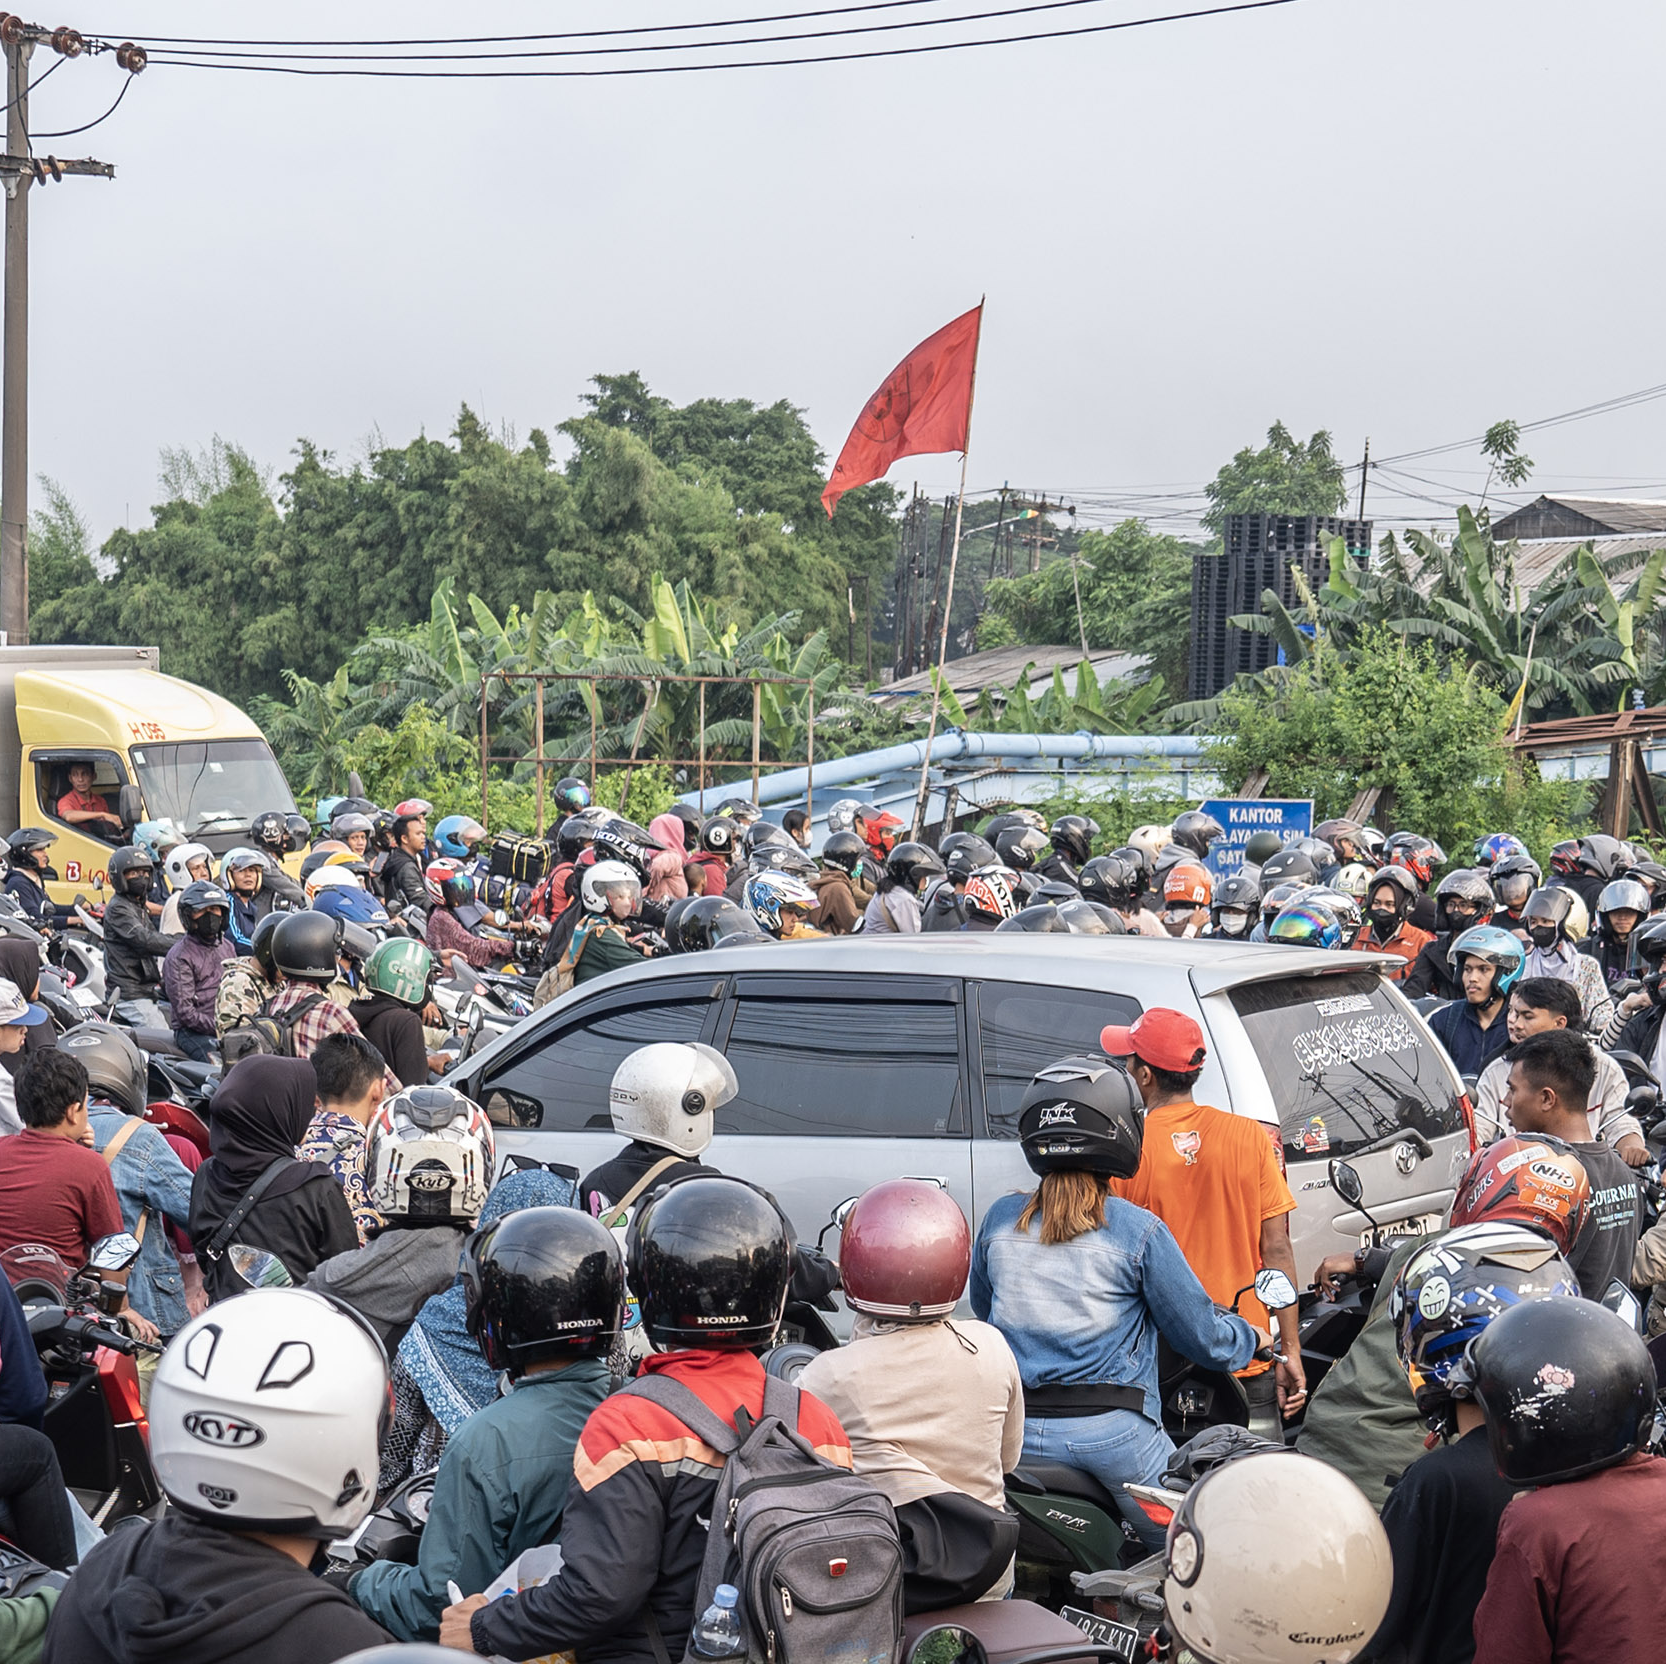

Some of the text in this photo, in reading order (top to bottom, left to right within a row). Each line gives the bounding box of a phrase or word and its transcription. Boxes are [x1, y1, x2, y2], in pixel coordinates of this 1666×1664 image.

[1228, 808, 1283, 833] KANTOR
[1282, 829, 1305, 844] SIM
[1531, 1165, 1575, 1188] NHK
[556, 1318, 605, 1331] HONDA
[696, 1315, 750, 1325] HONDA
[186, 1413, 262, 1444] KYT
